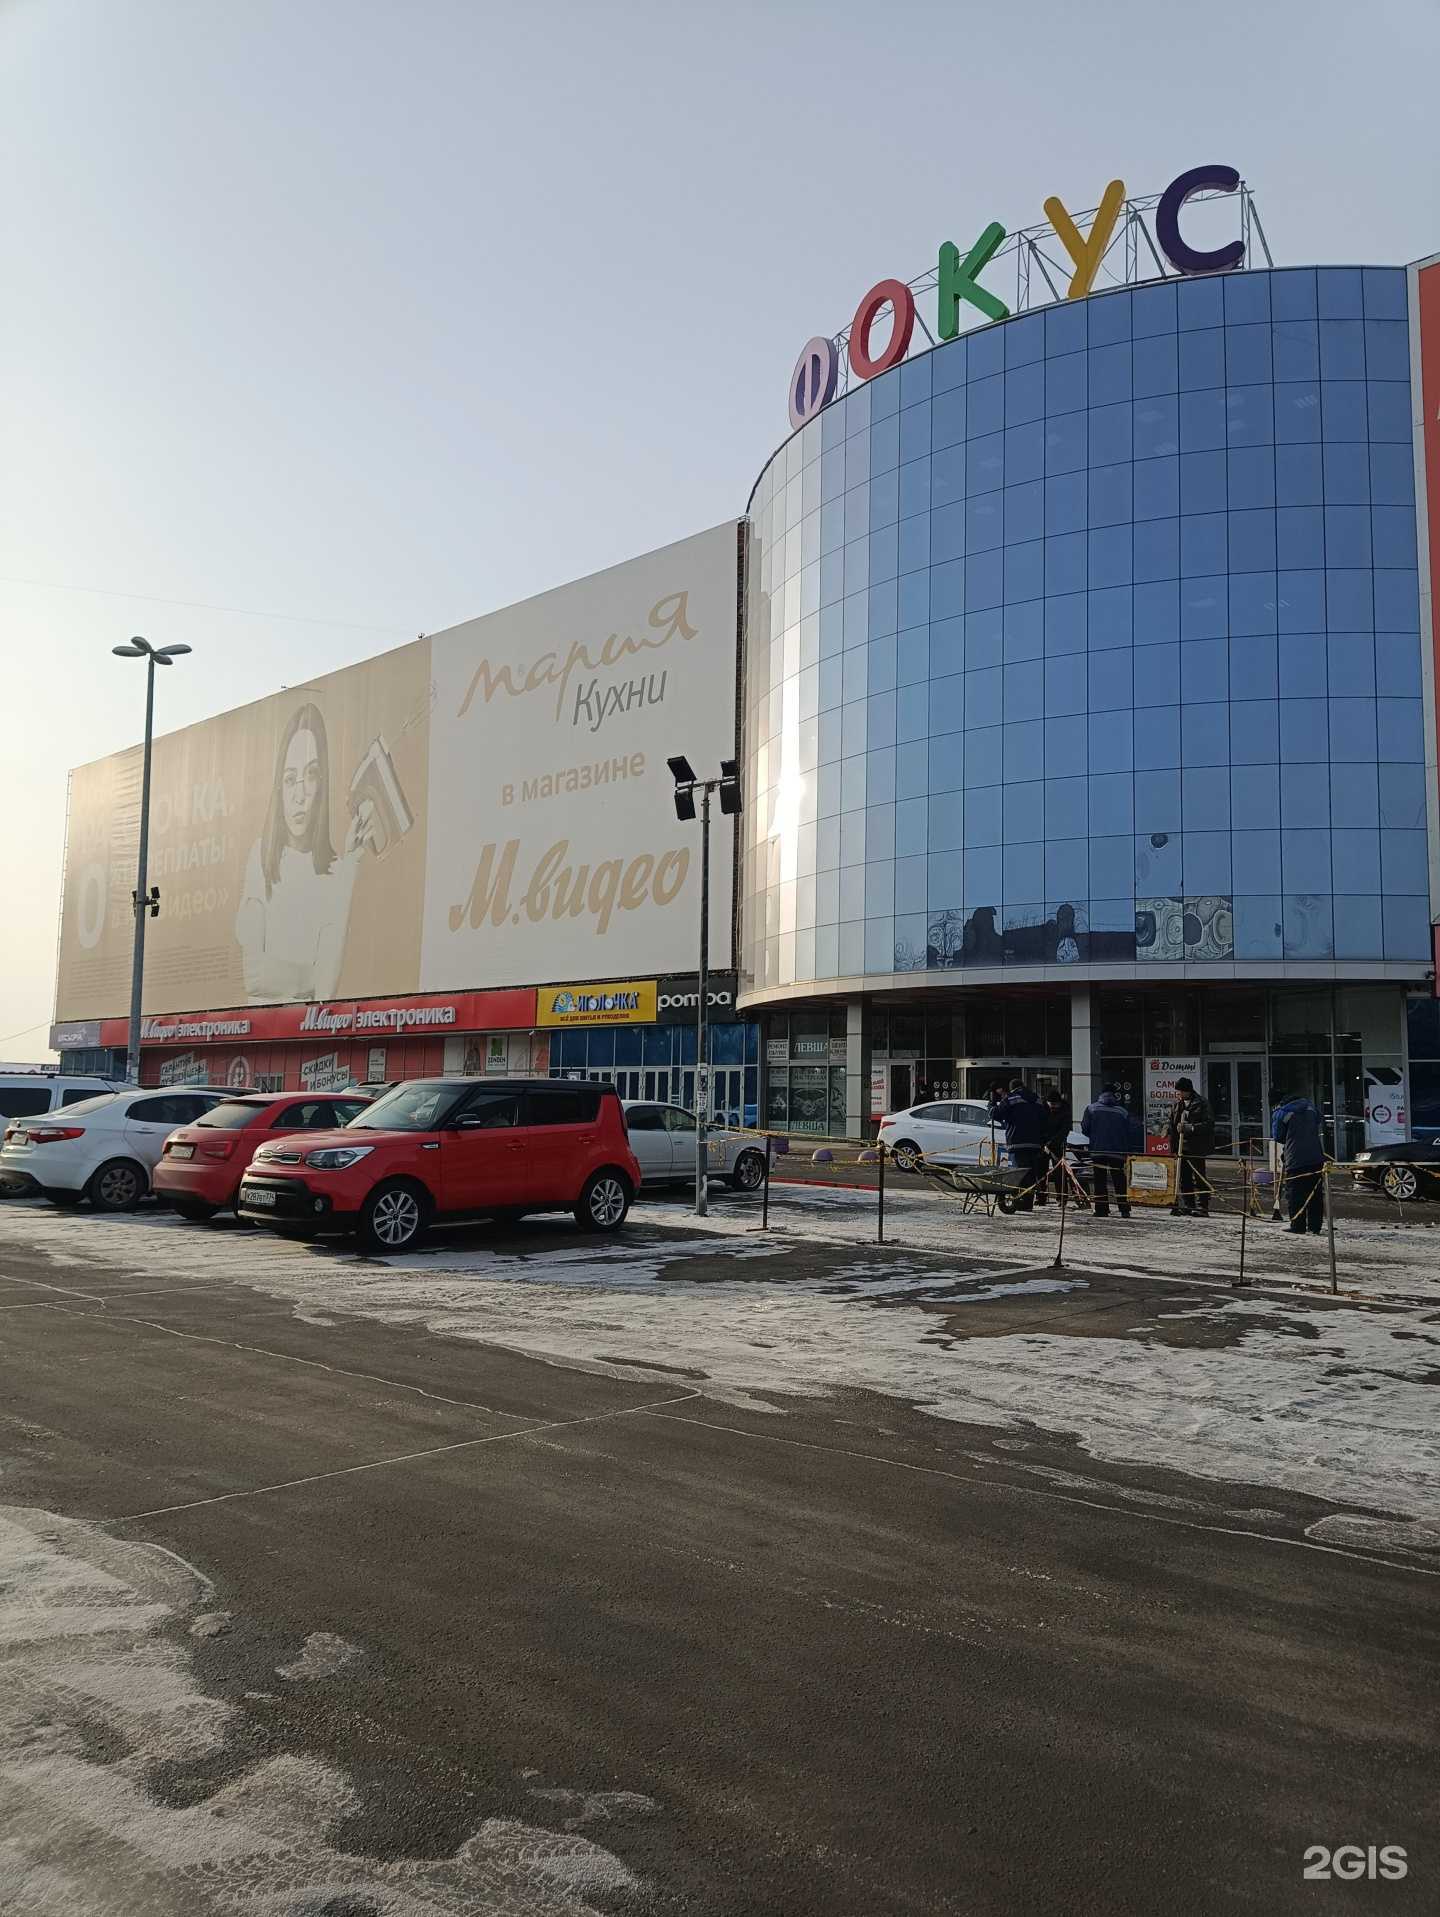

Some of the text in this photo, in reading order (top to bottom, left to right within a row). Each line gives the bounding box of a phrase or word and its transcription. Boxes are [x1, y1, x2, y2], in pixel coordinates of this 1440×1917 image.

[788, 165, 1244, 432] ФОКУС
[573, 670, 668, 732] Кухни
[502, 751, 646, 806] в магазине
[577, 991, 640, 1012] ИГОЛОЧКА
[355, 1007, 456, 1032] электроника
[177, 1020, 250, 1041] электроника
[794, 1042, 828, 1053] ЛЕВША
[302, 1055, 335, 1075] СКИДКИ
[1162, 1060, 1196, 1072] Dommi
[316, 1071, 348, 1089] БОНУСЫ
[1156, 1080, 1175, 1089] САМ
[1150, 1091, 1177, 1100] БОЛЬ
